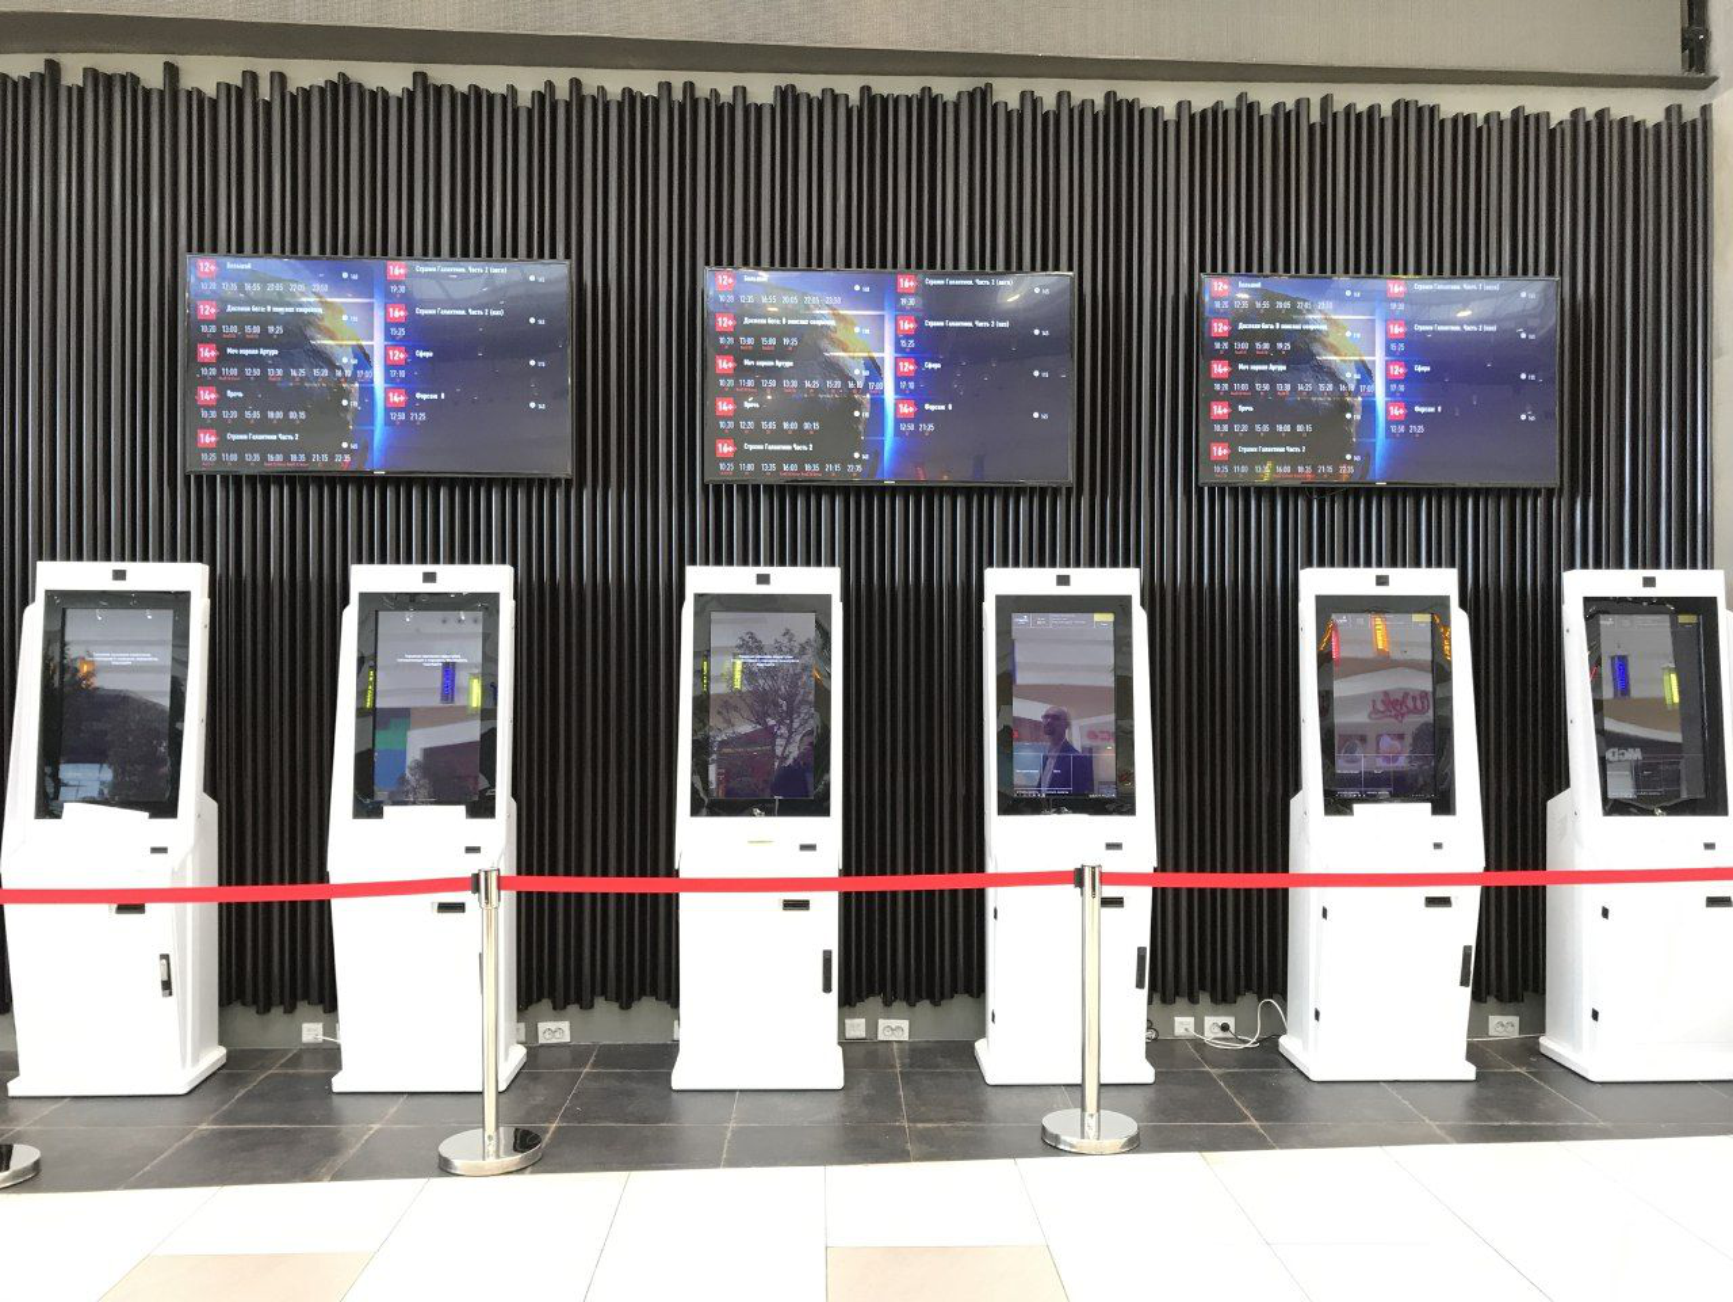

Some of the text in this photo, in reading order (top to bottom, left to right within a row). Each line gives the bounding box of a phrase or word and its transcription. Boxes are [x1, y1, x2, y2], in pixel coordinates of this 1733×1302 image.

[199, 263, 216, 272] 12+
[199, 305, 216, 315] 12+
[200, 348, 216, 358] 16+
[389, 351, 405, 360] 12+
[222, 368, 238, 376] 11:00
[200, 434, 216, 443] 16+
[222, 453, 238, 462] 11:00
